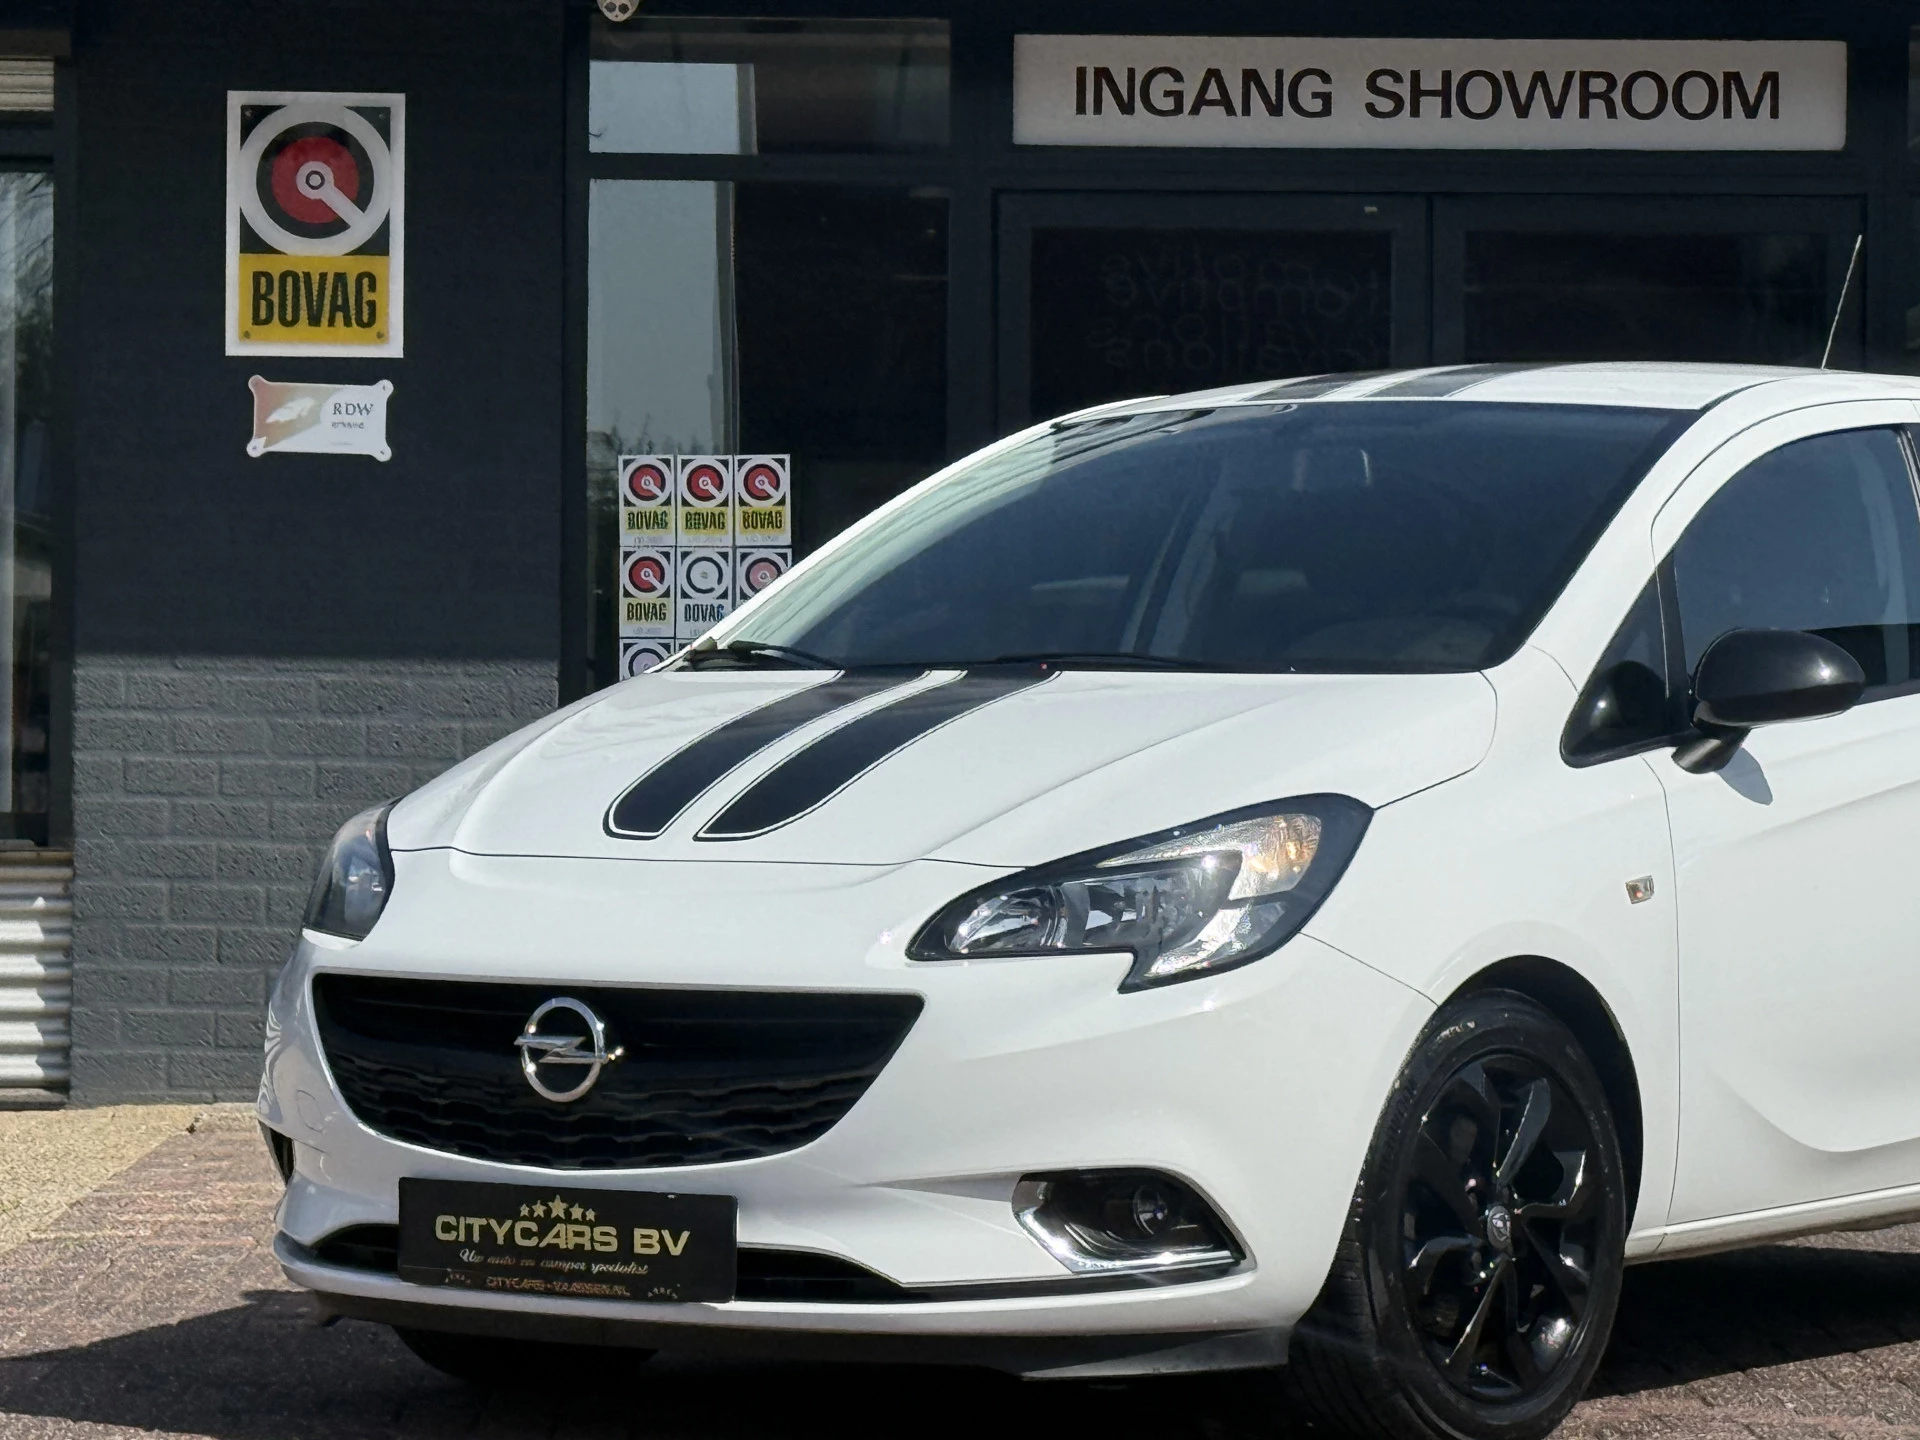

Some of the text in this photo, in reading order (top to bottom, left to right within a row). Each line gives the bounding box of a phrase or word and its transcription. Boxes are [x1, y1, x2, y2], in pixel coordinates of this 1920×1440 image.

[1074, 65, 1781, 121] INGANG SHOWROOM
[251, 270, 378, 330] BOVAG
[331, 402, 374, 416] RDW
[627, 510, 668, 530] BOVAG
[685, 510, 726, 530] BOVAG
[742, 509, 783, 530] BOVAG
[626, 602, 667, 621] BOVAG
[434, 1214, 691, 1257] CITYCARS BV
